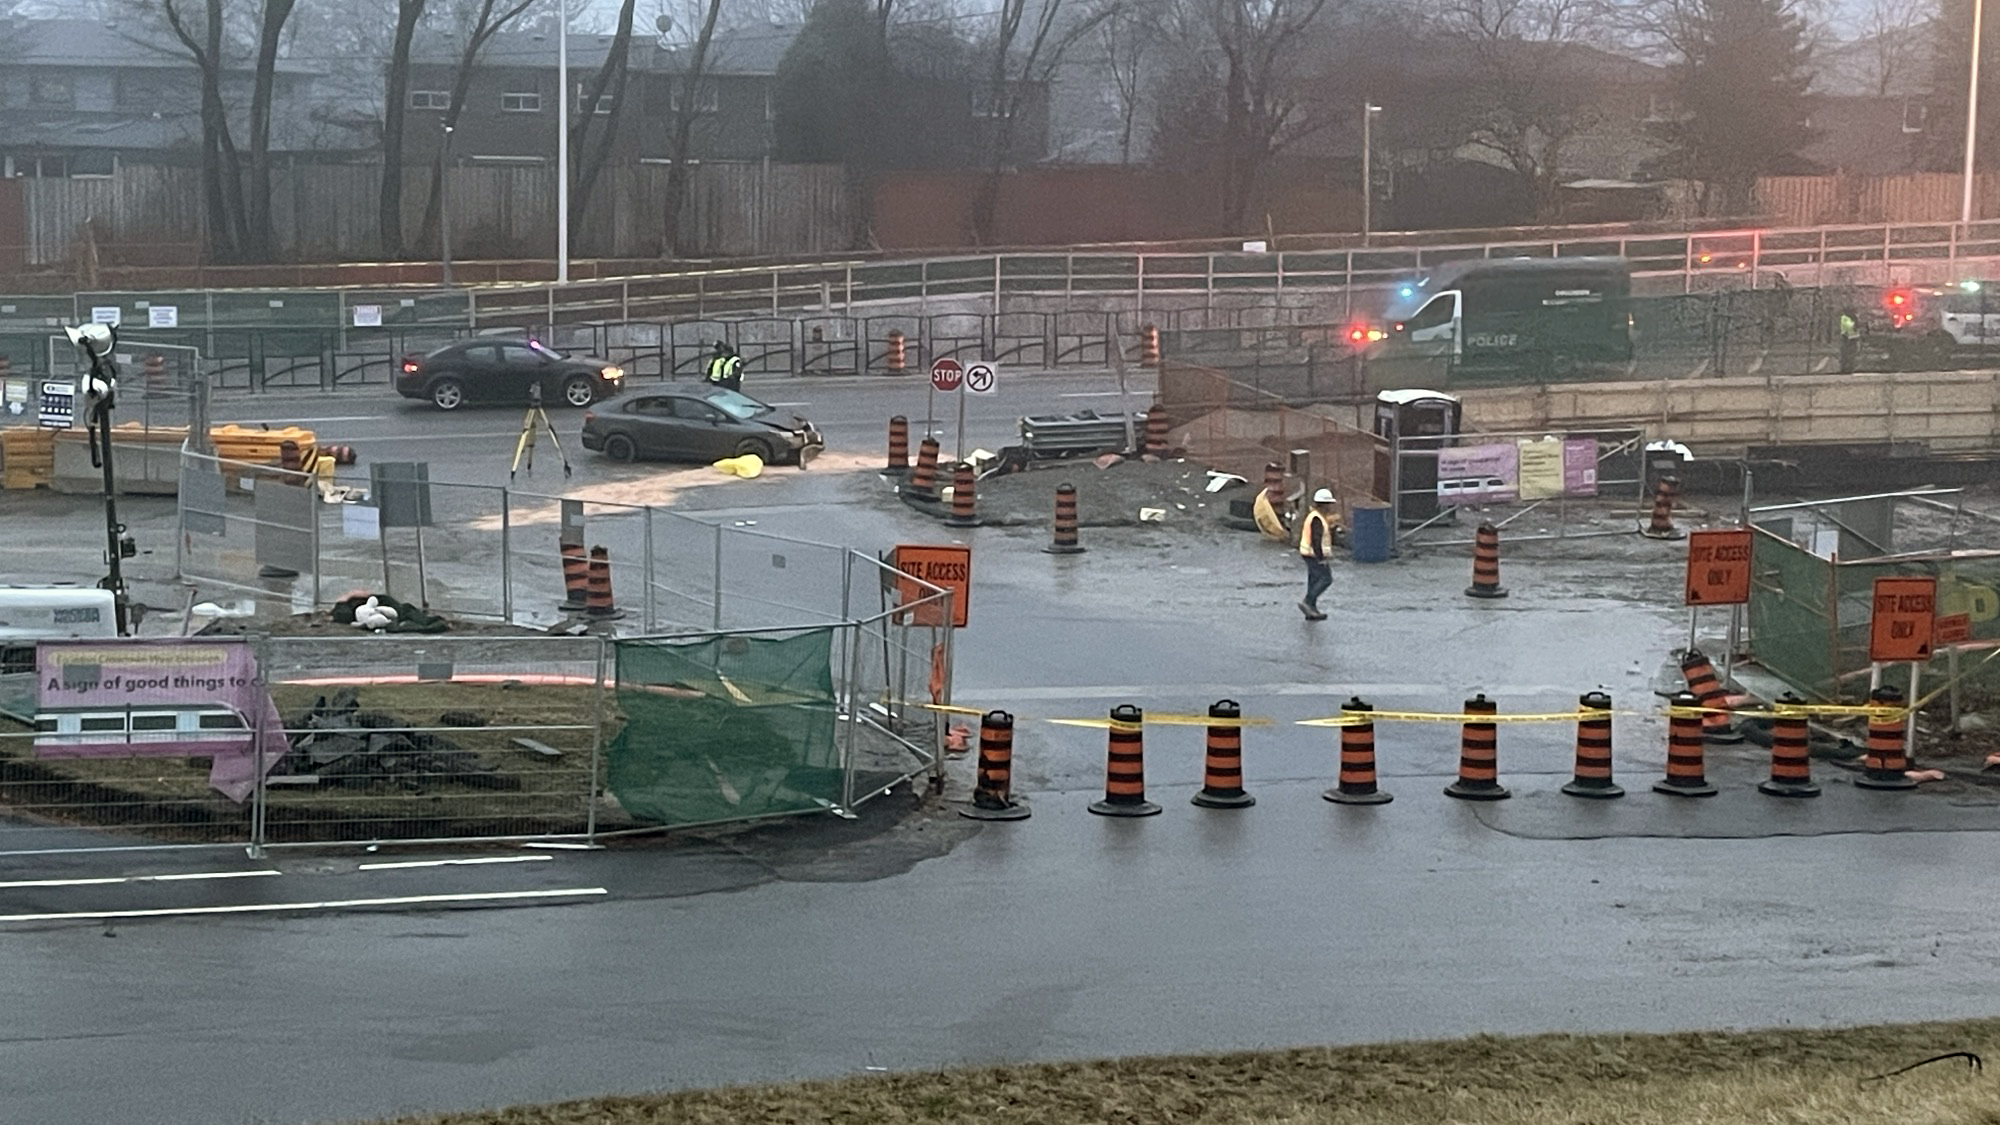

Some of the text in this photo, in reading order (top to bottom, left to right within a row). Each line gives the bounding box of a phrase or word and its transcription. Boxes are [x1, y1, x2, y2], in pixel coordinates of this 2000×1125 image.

[1466, 333, 1519, 347] POLICE
[933, 368, 962, 383] STOP
[1692, 545, 1749, 563] SITE ACCESS
[900, 561, 966, 582] SITE ACCESS
[1707, 568, 1733, 586] ONLY
[1877, 594, 1932, 614] SITE ACCESS
[1891, 620, 1916, 639] ONLY
[47, 677, 60, 691] A
[103, 675, 121, 690] of
[125, 674, 169, 693] good
[173, 674, 225, 692] things
[229, 676, 246, 688] to
